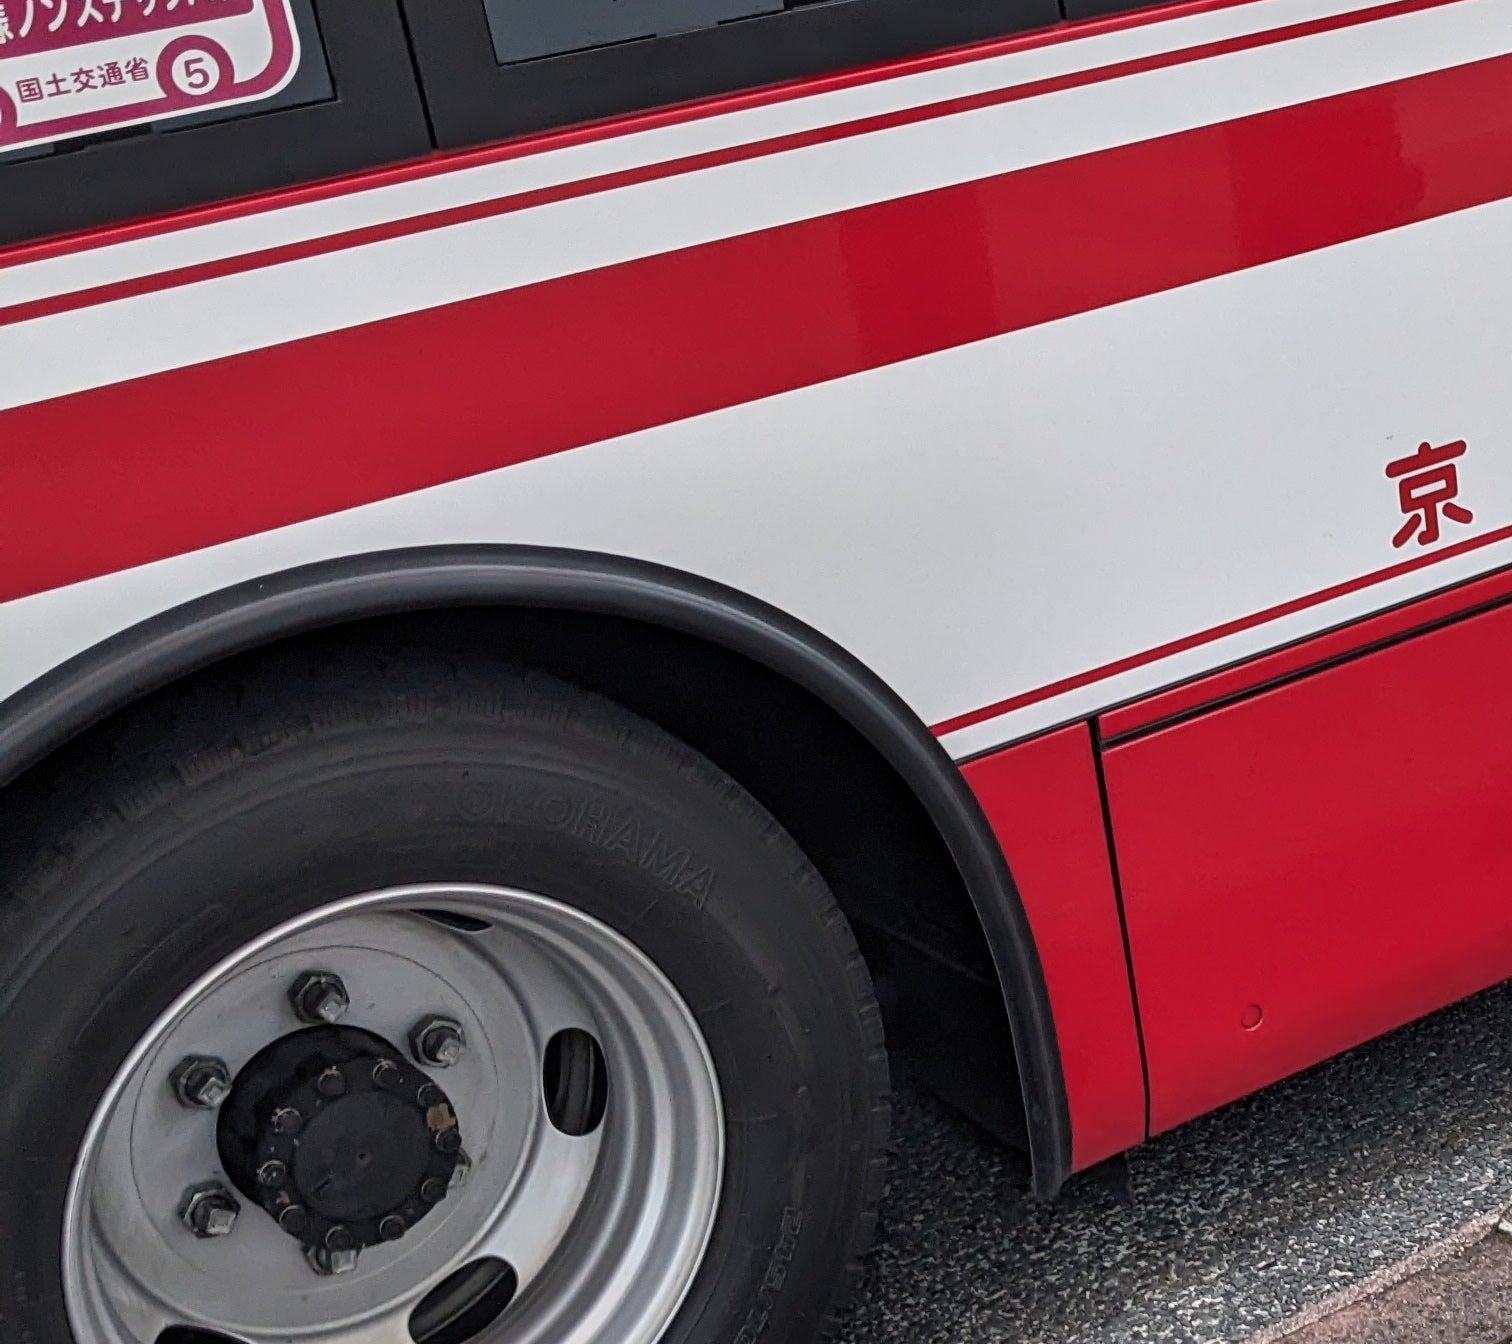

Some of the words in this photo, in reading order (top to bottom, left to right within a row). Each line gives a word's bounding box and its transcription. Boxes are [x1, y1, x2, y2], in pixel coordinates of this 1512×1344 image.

[16, 57, 150, 103] 国土交通省
